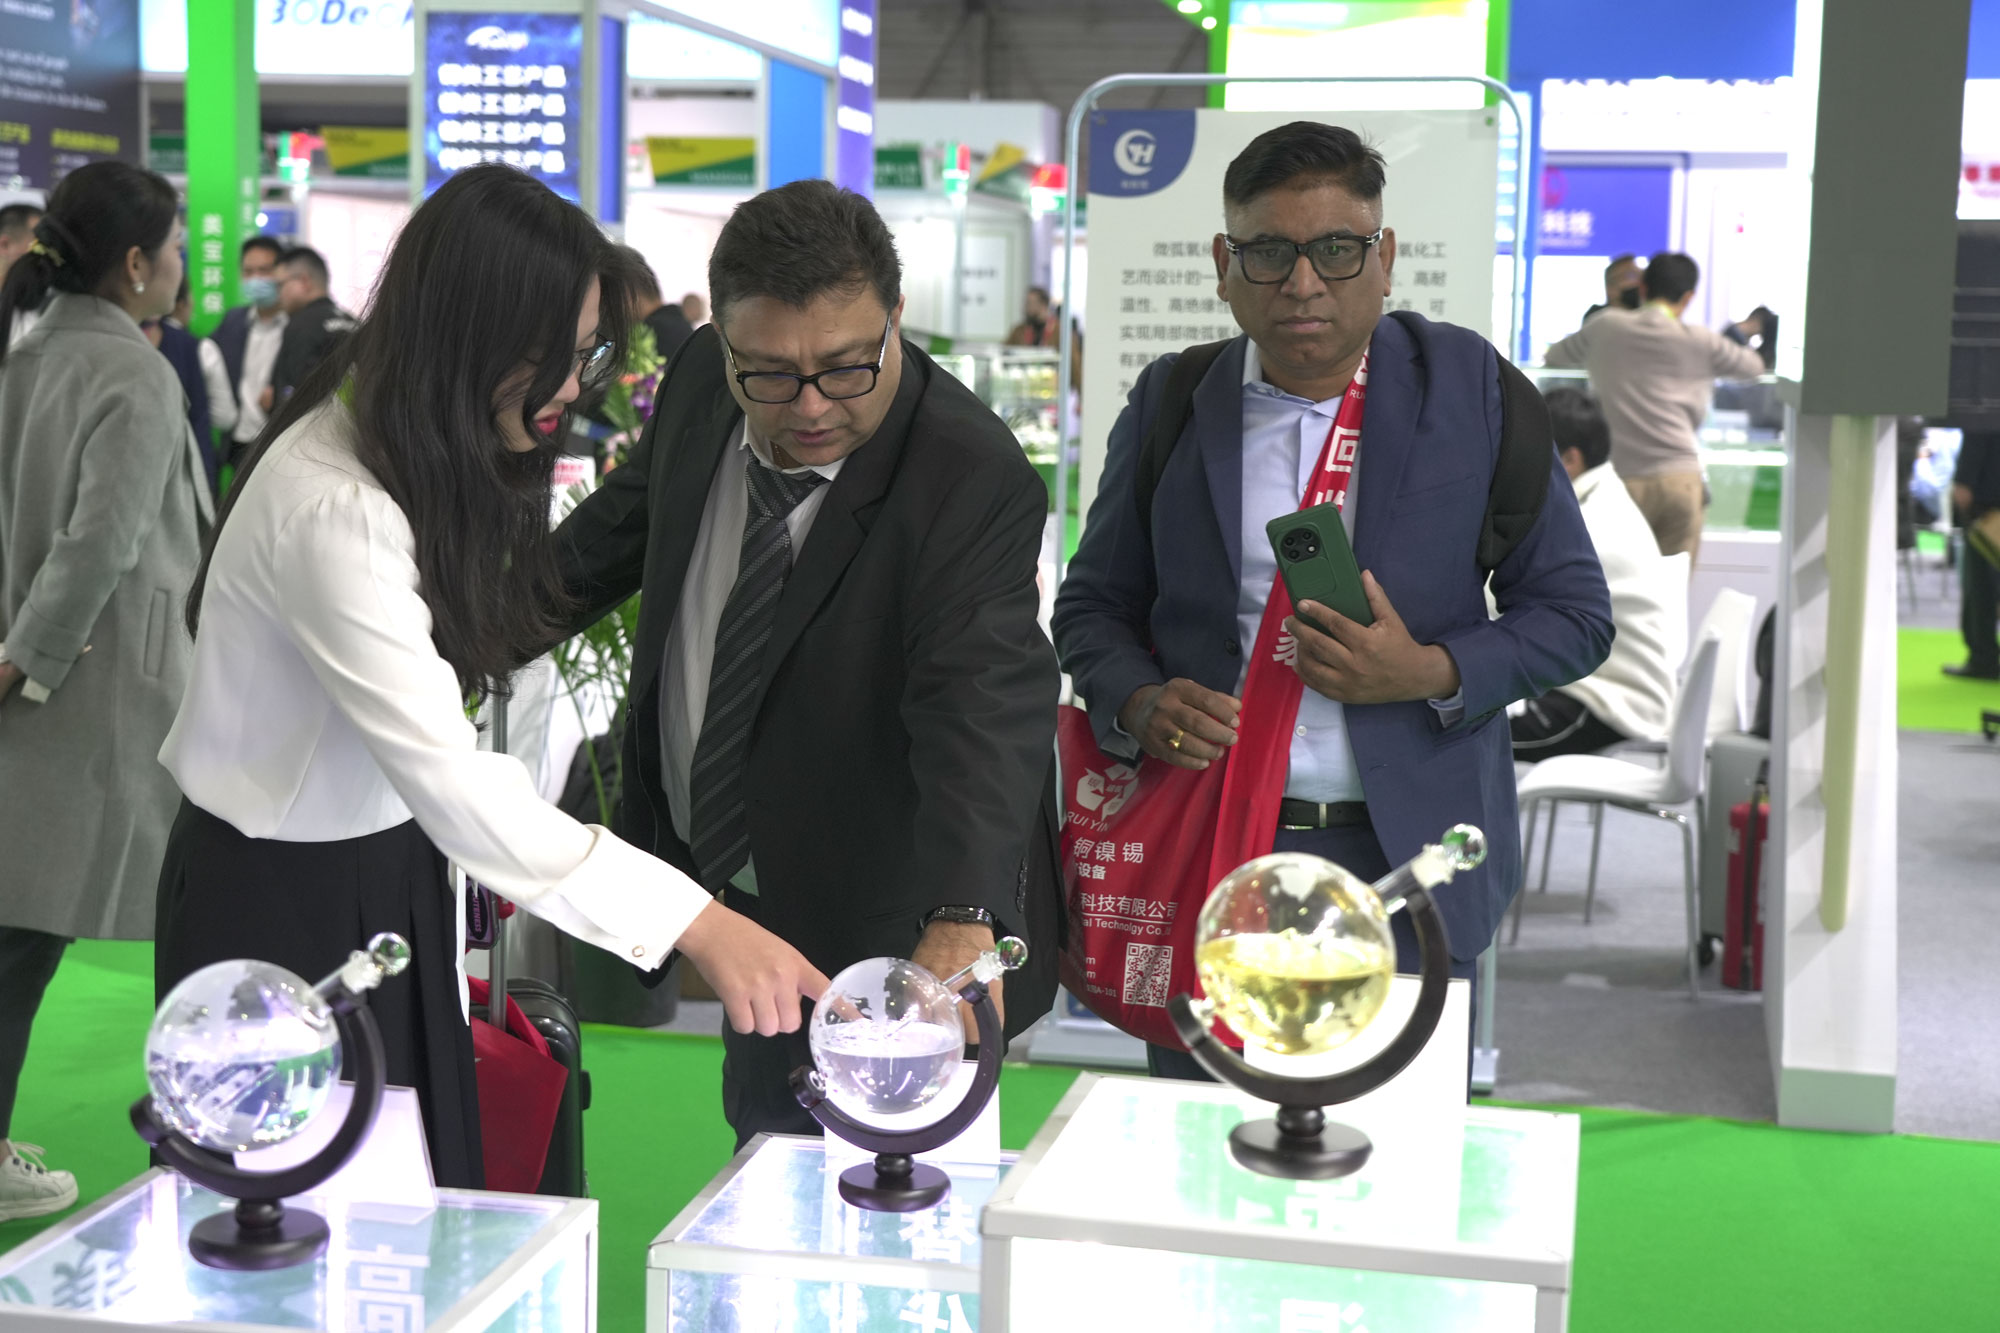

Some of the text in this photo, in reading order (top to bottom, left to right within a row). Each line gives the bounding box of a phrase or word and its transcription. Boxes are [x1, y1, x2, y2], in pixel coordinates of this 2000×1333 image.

[1081, 892, 1178, 920] 科技有限公司
